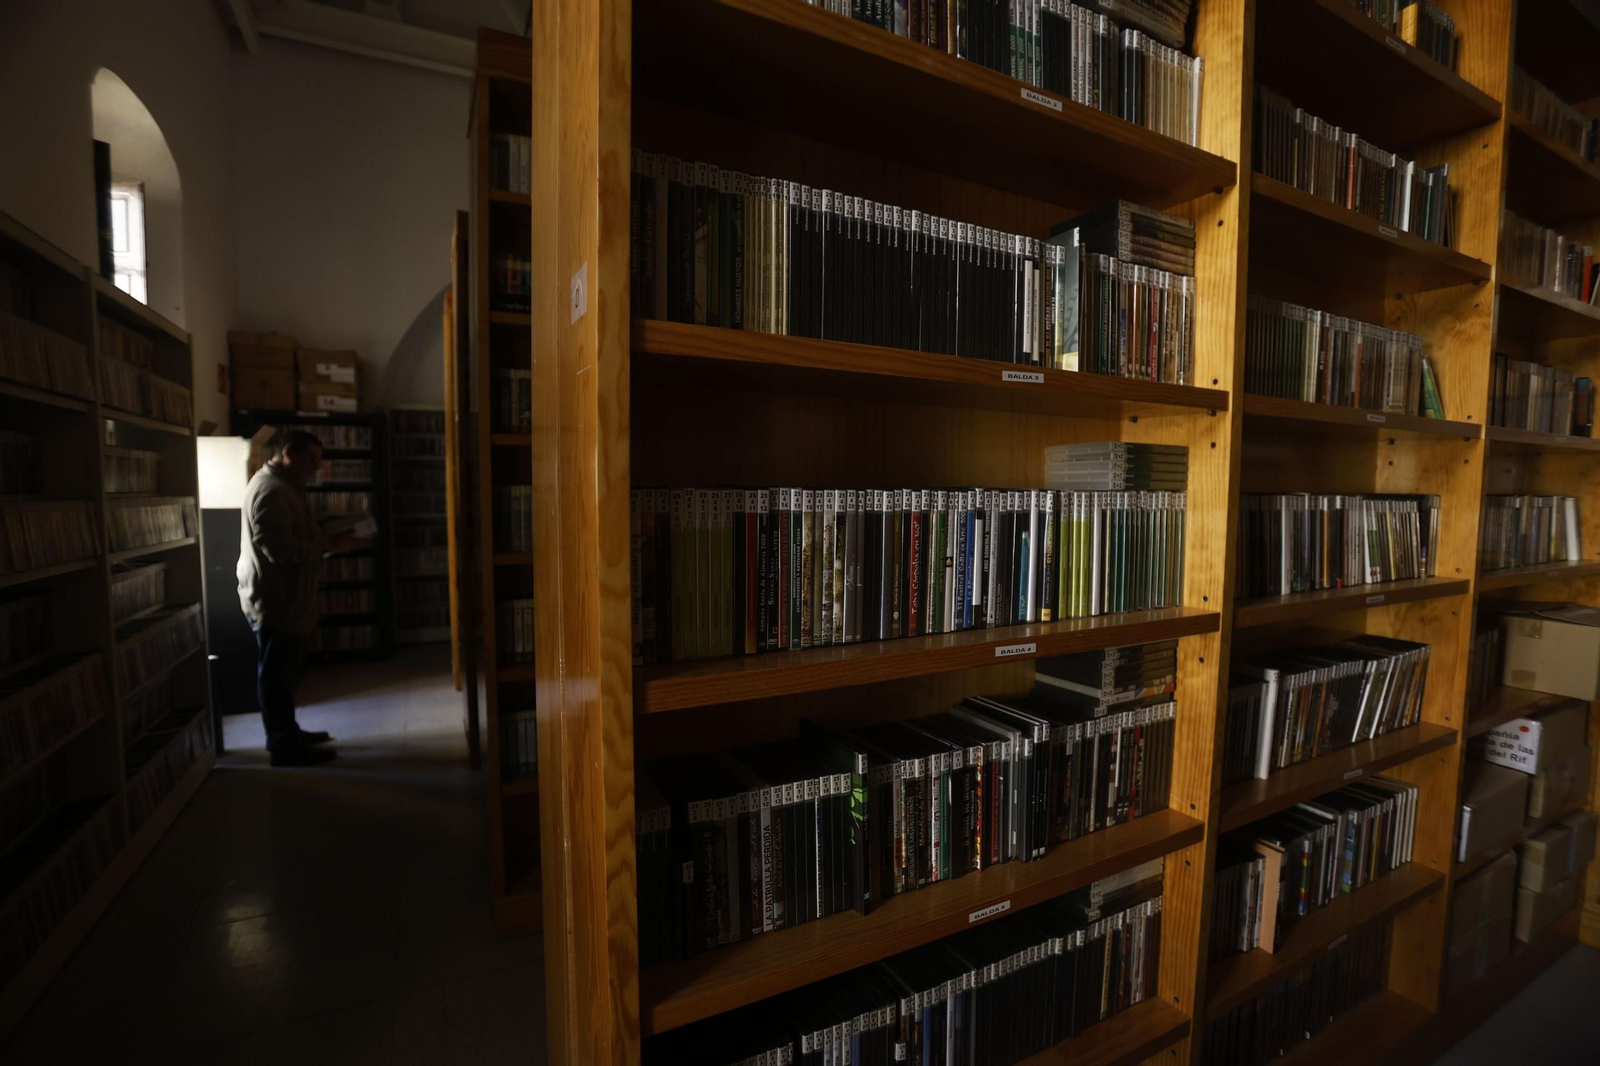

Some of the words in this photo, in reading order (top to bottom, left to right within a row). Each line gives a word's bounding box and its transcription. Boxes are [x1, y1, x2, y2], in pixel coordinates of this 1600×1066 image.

[1026, 92, 1052, 106] BALDA
[1500, 742, 1514, 750] de
[1518, 744, 1534, 755] las
[1490, 750, 1506, 758] del
[1510, 754, 1526, 763] Rif
[763, 824, 771, 865] PERDIDA
[764, 866, 772, 912] PATRULLA
[766, 914, 773, 926] LA
[974, 908, 1000, 919] BALDA
